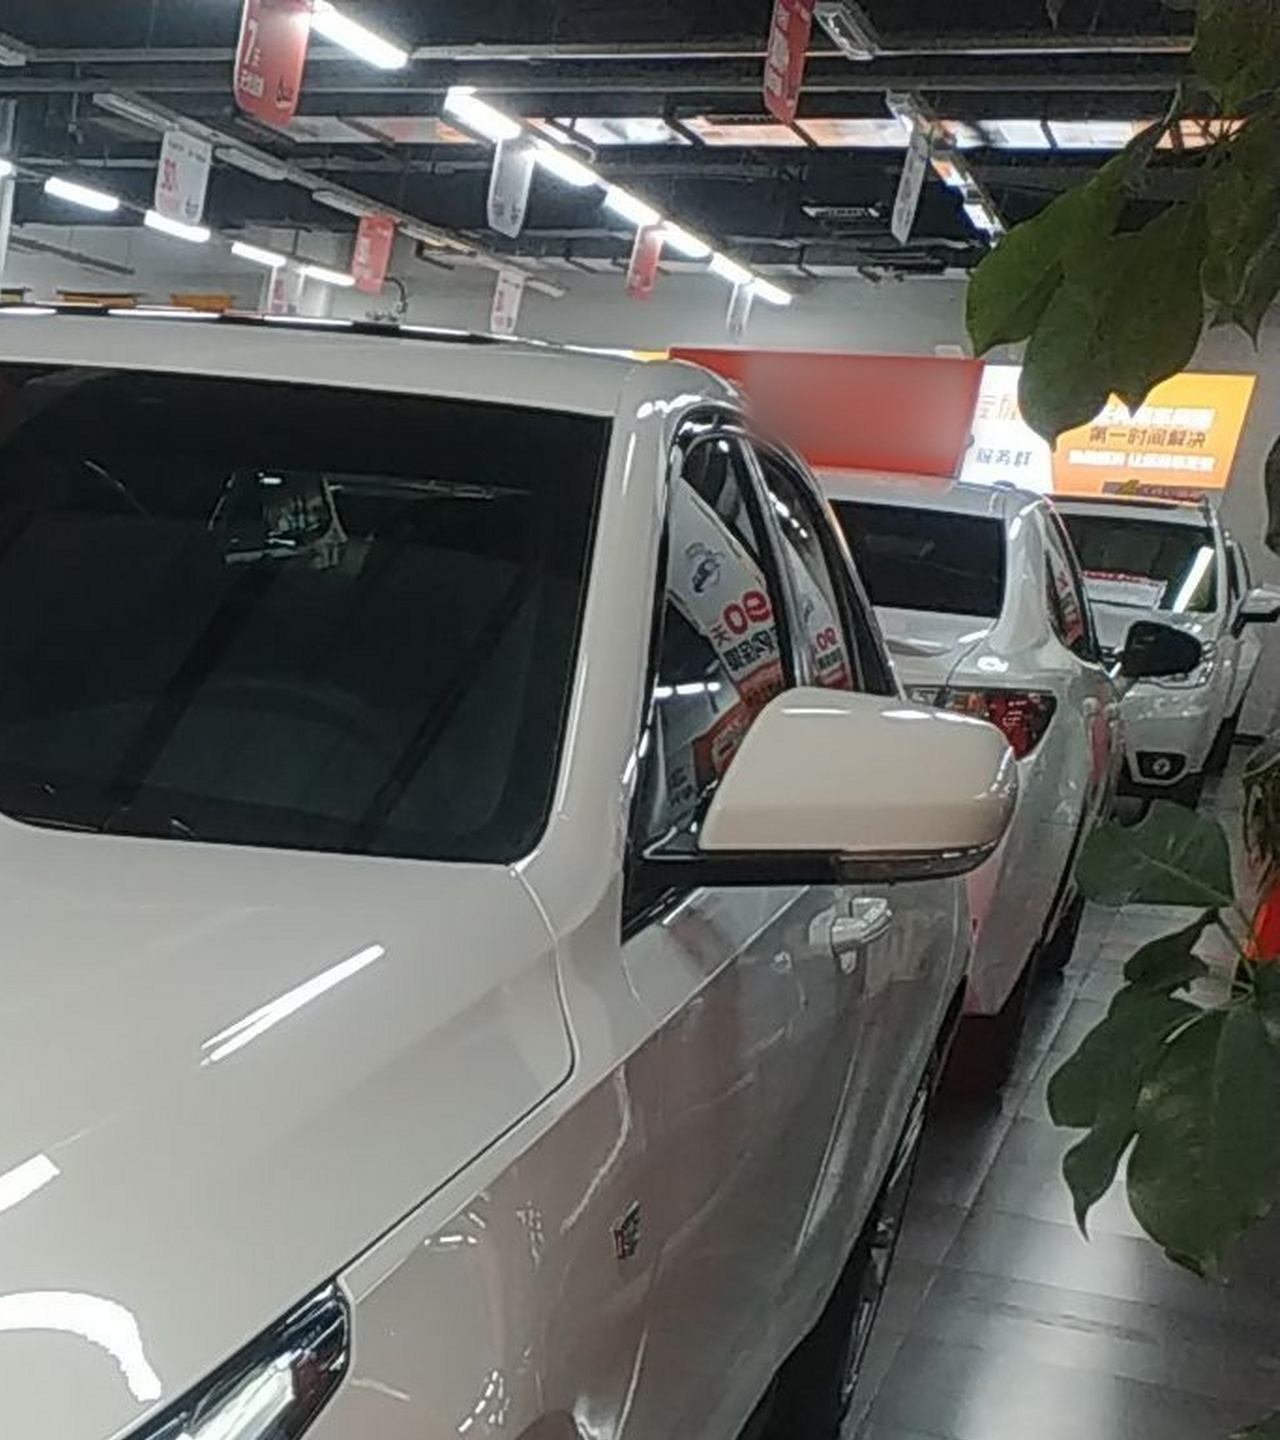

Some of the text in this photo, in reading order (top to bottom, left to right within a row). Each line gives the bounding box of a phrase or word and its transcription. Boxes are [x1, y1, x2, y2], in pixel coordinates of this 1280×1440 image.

[1090, 426, 1207, 449] 第一时间解决
